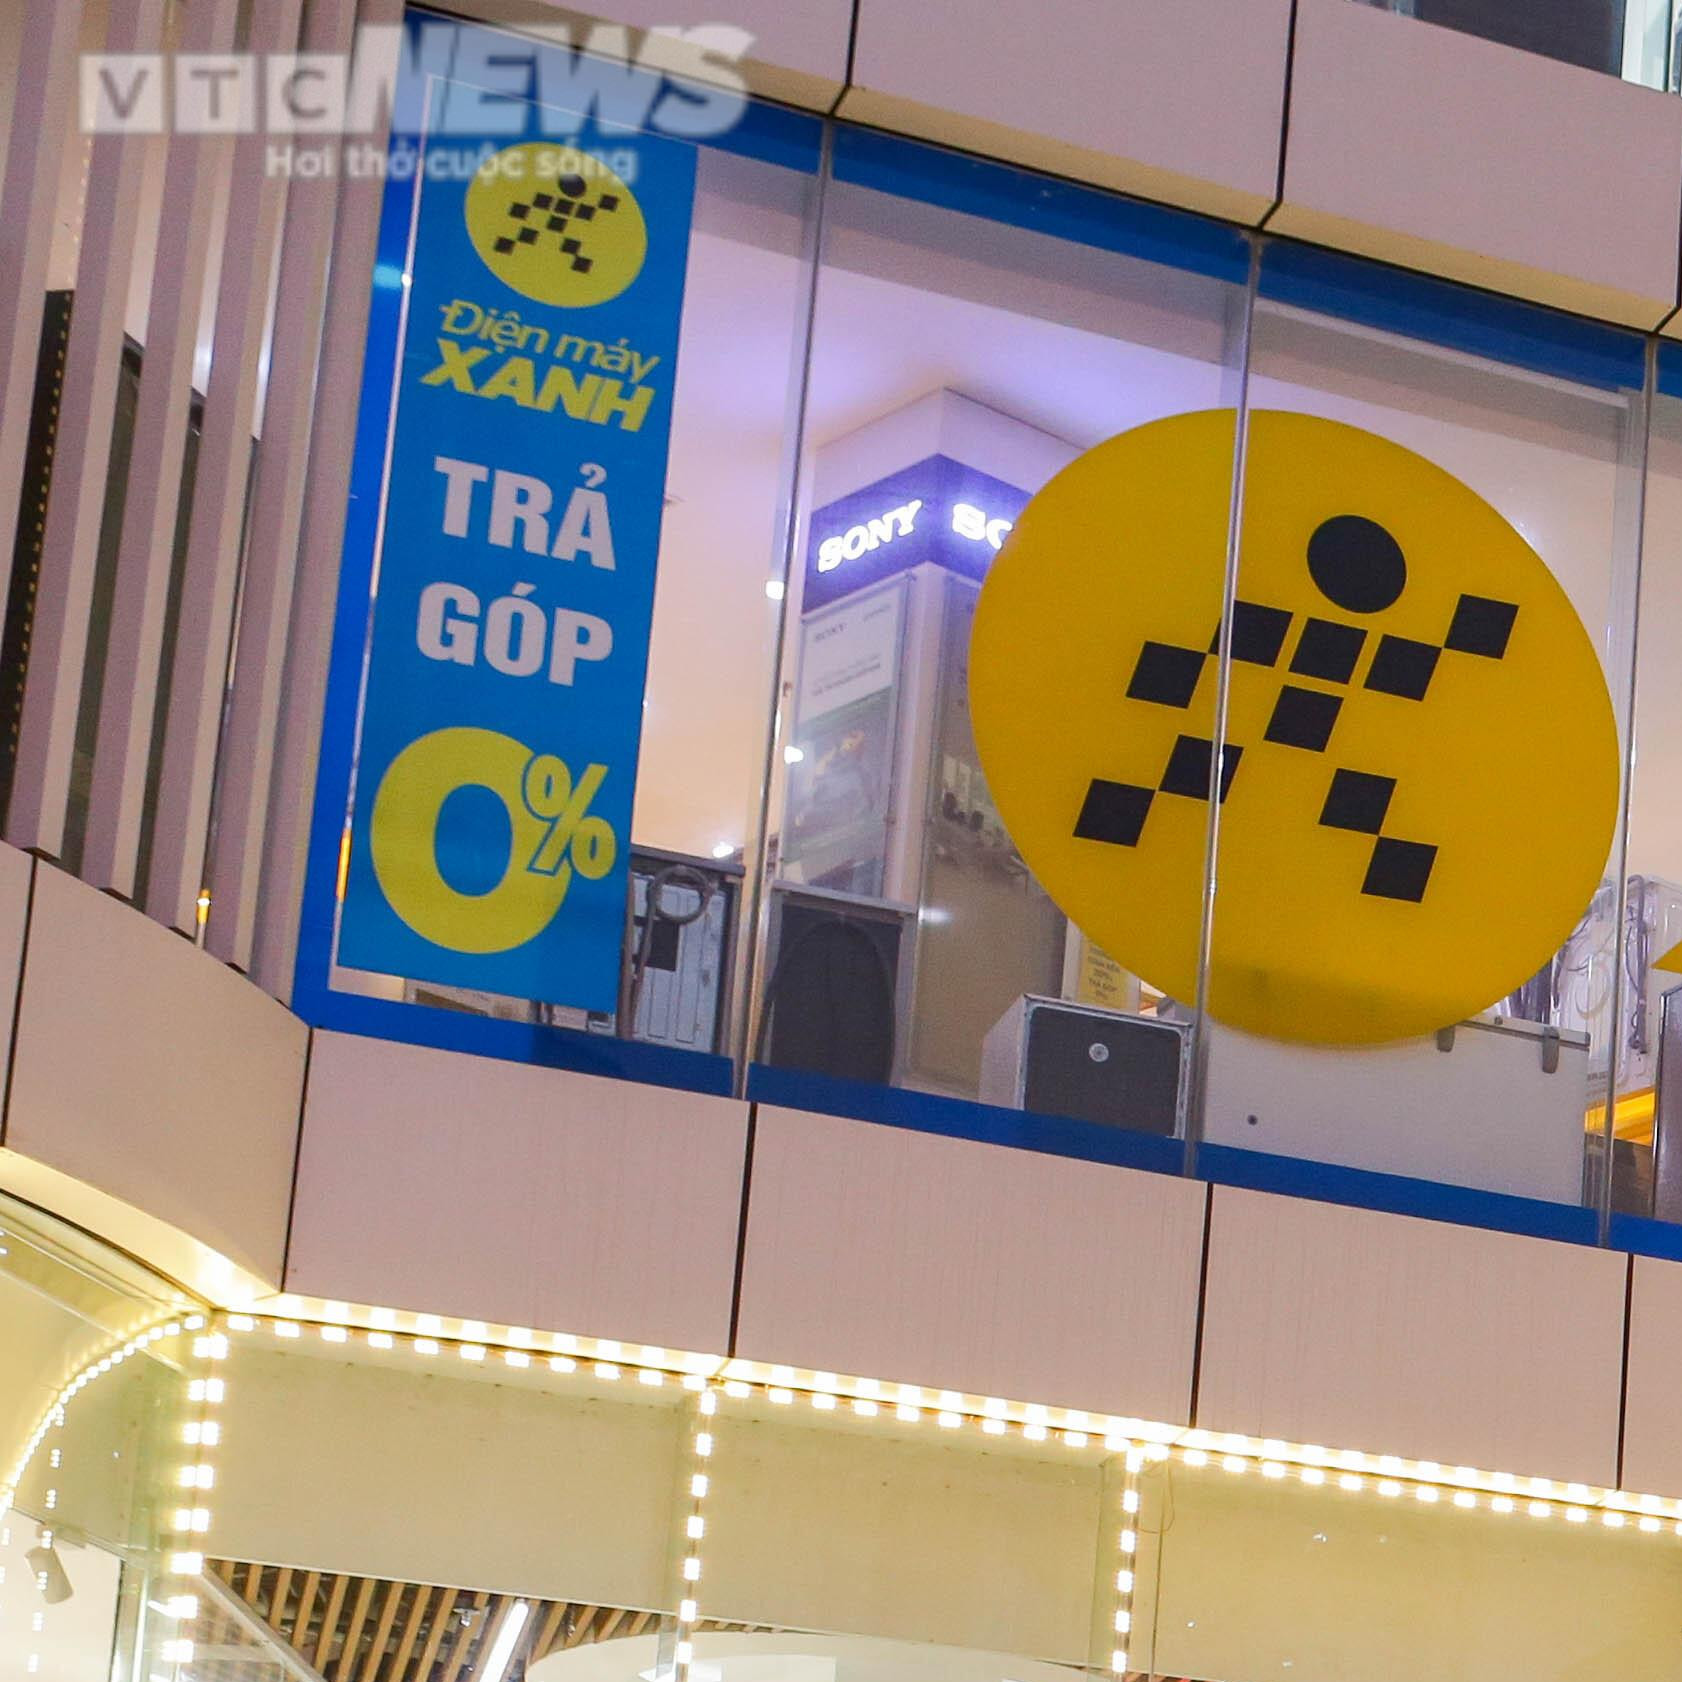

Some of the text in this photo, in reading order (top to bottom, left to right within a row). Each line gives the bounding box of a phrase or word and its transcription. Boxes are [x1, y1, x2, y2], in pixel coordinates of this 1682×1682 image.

[419, 337, 655, 433] XANH
[440, 298, 662, 379] Điện máy
[433, 456, 617, 571] TRẢ
[817, 499, 923, 573] SONY
[415, 582, 613, 688] GÓP
[370, 725, 616, 955] 0%
